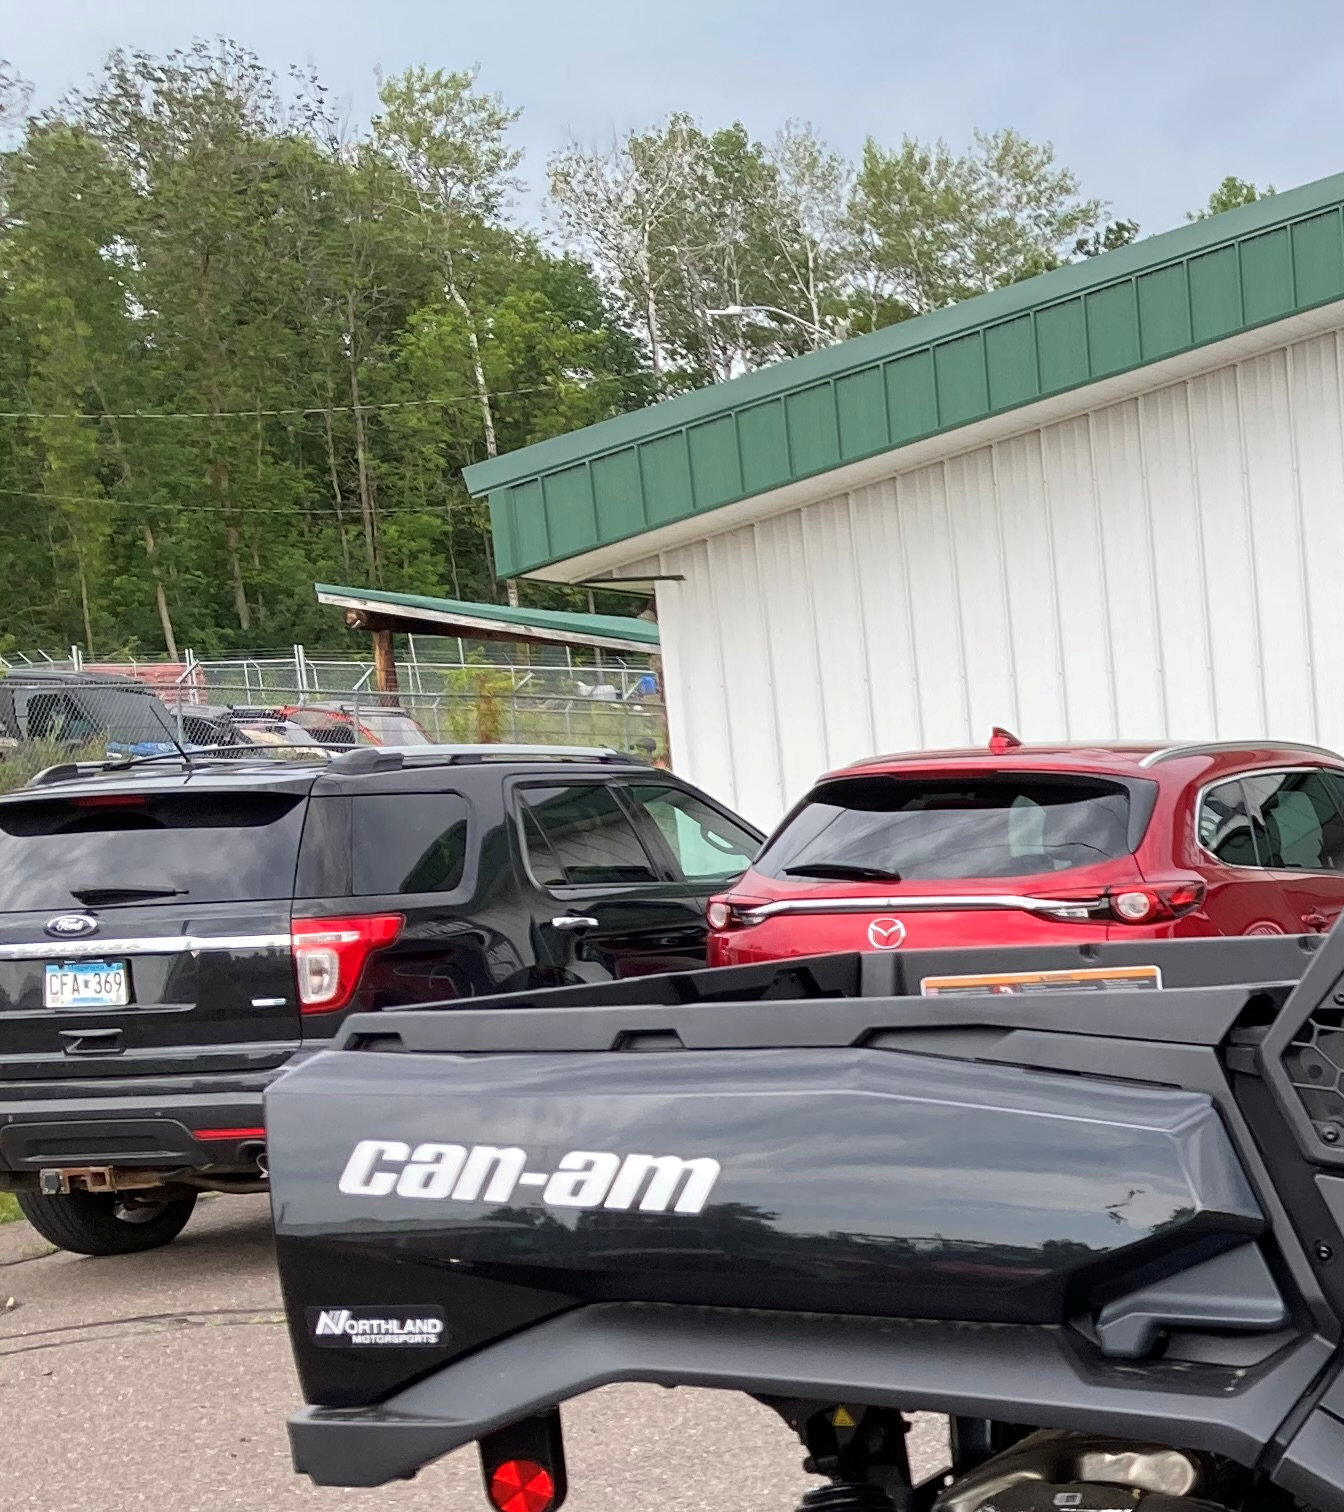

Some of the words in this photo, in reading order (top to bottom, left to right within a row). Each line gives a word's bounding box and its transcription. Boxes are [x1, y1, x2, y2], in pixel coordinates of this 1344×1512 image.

[338, 1140, 720, 1214] can-am
[315, 1310, 443, 1334] NORTHLAND
[352, 1335, 439, 1343] MOTORSPORTS
